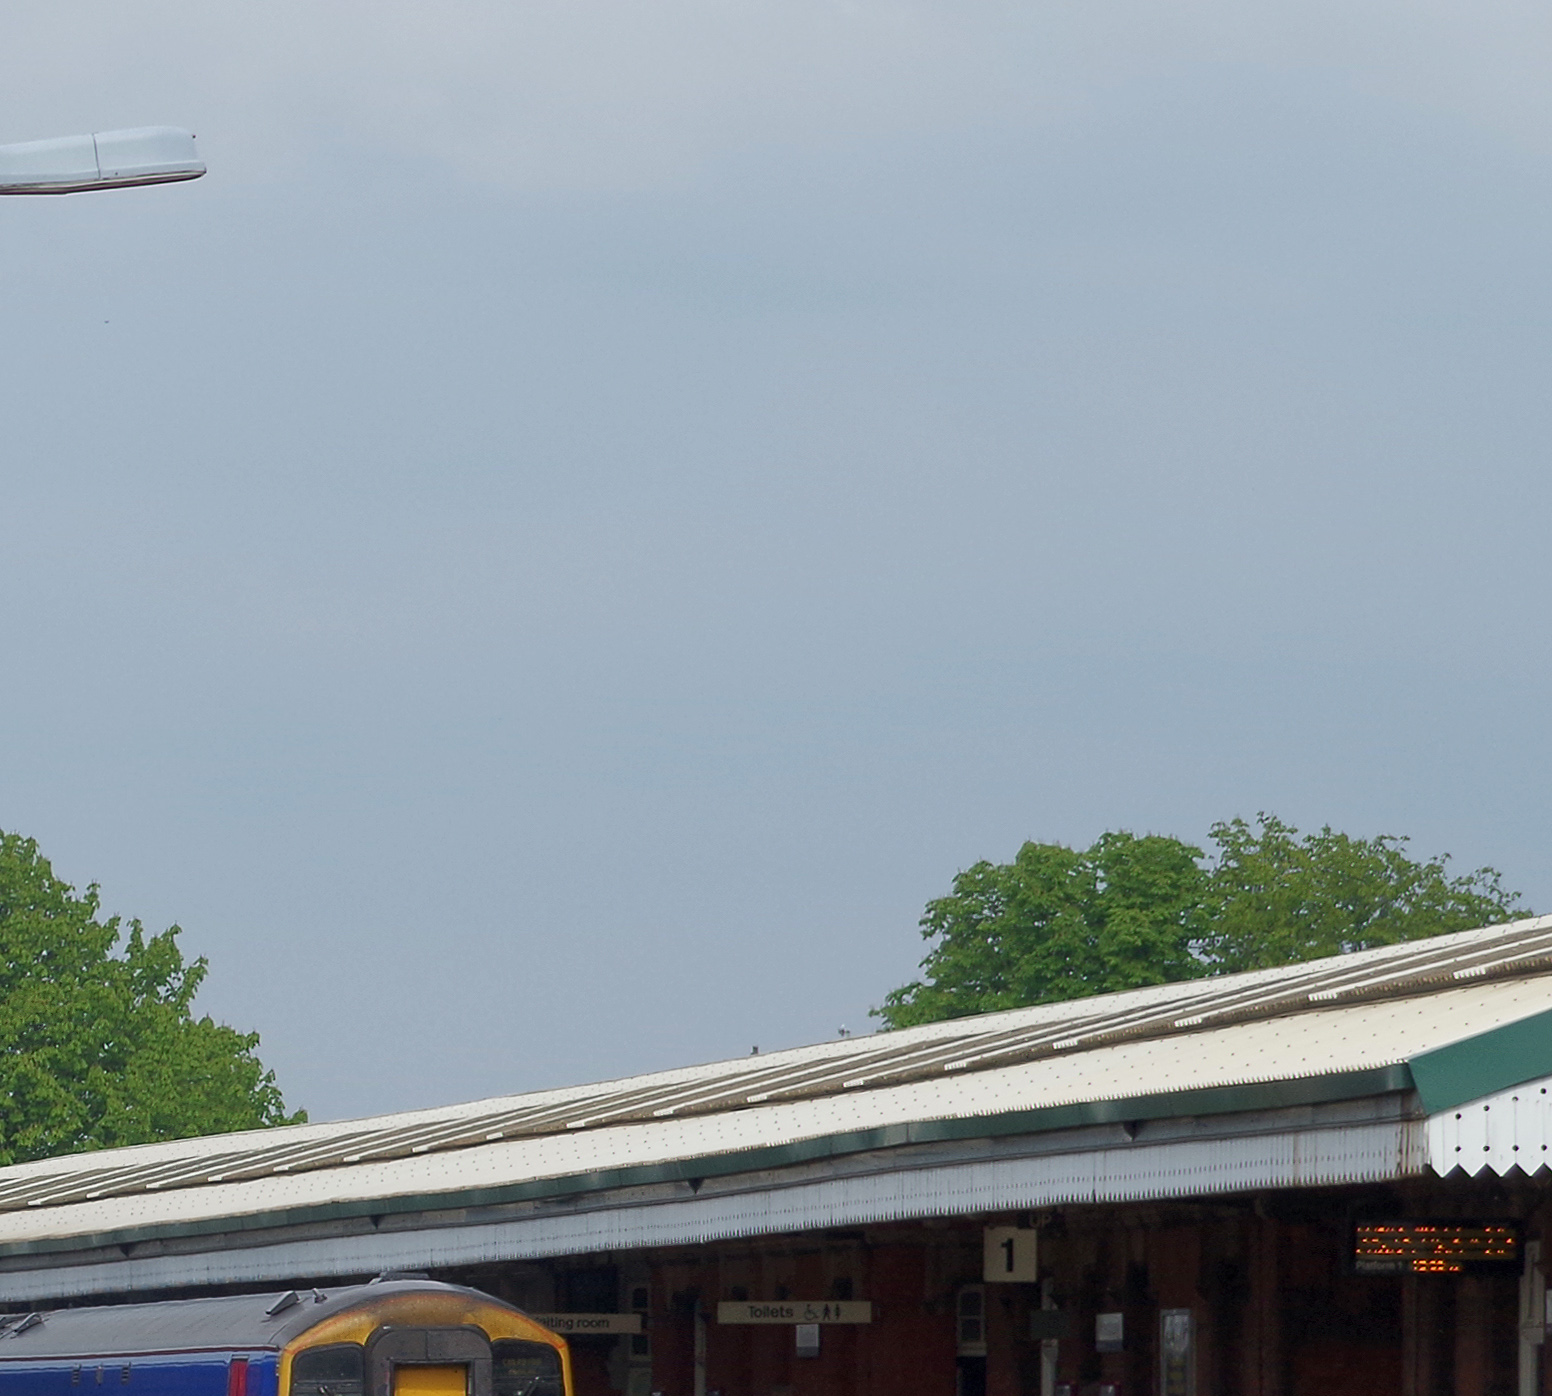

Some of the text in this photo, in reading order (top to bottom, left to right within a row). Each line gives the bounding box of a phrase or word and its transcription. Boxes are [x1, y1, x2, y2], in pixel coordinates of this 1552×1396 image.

[1001, 1238, 1014, 1272] 1
[1356, 1261, 1395, 1270] Platform
[748, 1305, 794, 1318] Toilets
[577, 1319, 609, 1328] room
